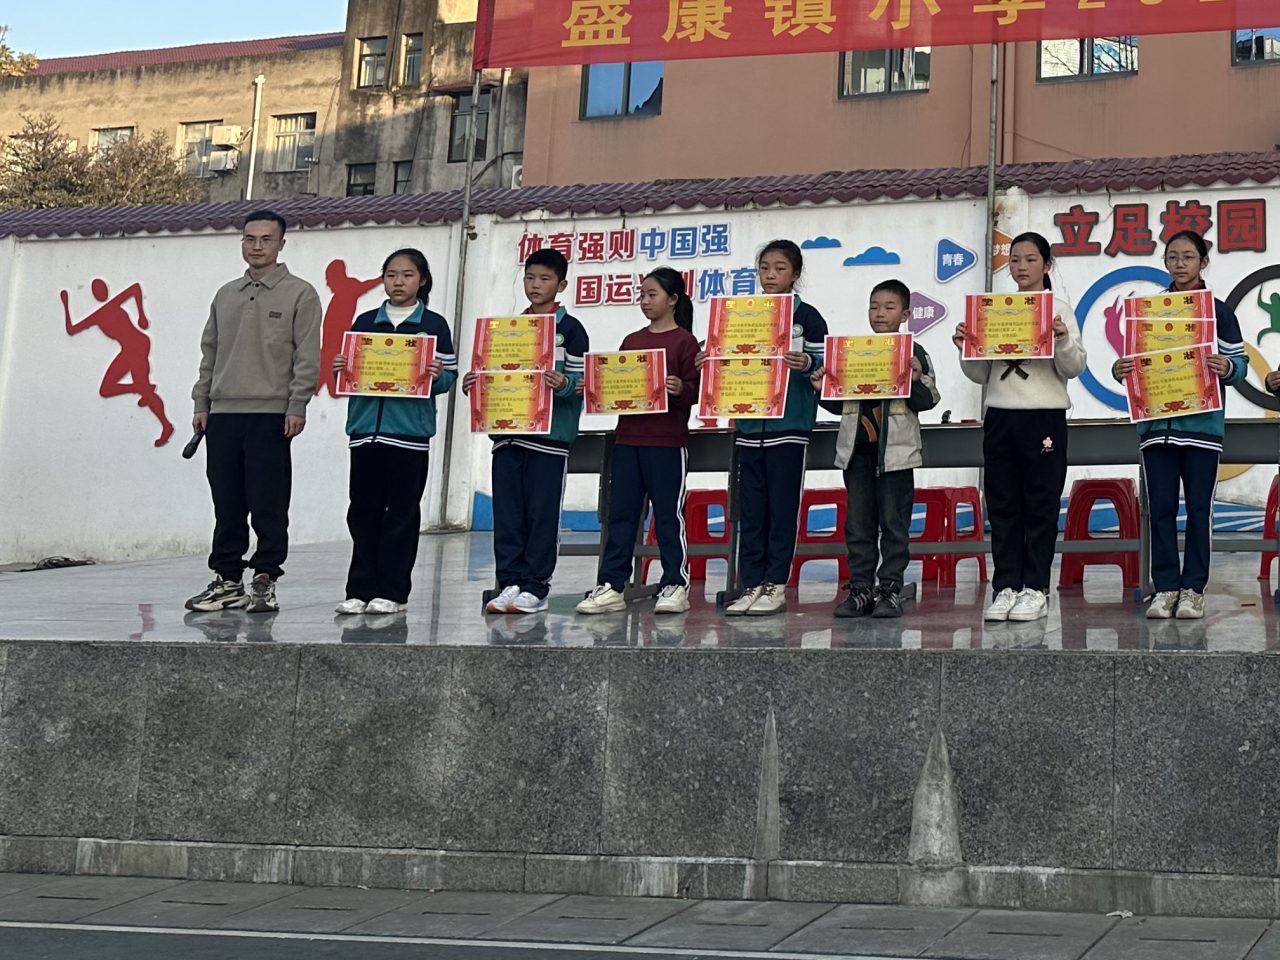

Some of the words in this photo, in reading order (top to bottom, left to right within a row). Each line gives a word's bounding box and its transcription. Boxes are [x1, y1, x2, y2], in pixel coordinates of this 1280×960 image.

[1050, 198, 1267, 258] 立足校园
[942, 253, 964, 267] 青春
[912, 306, 935, 320] 健康
